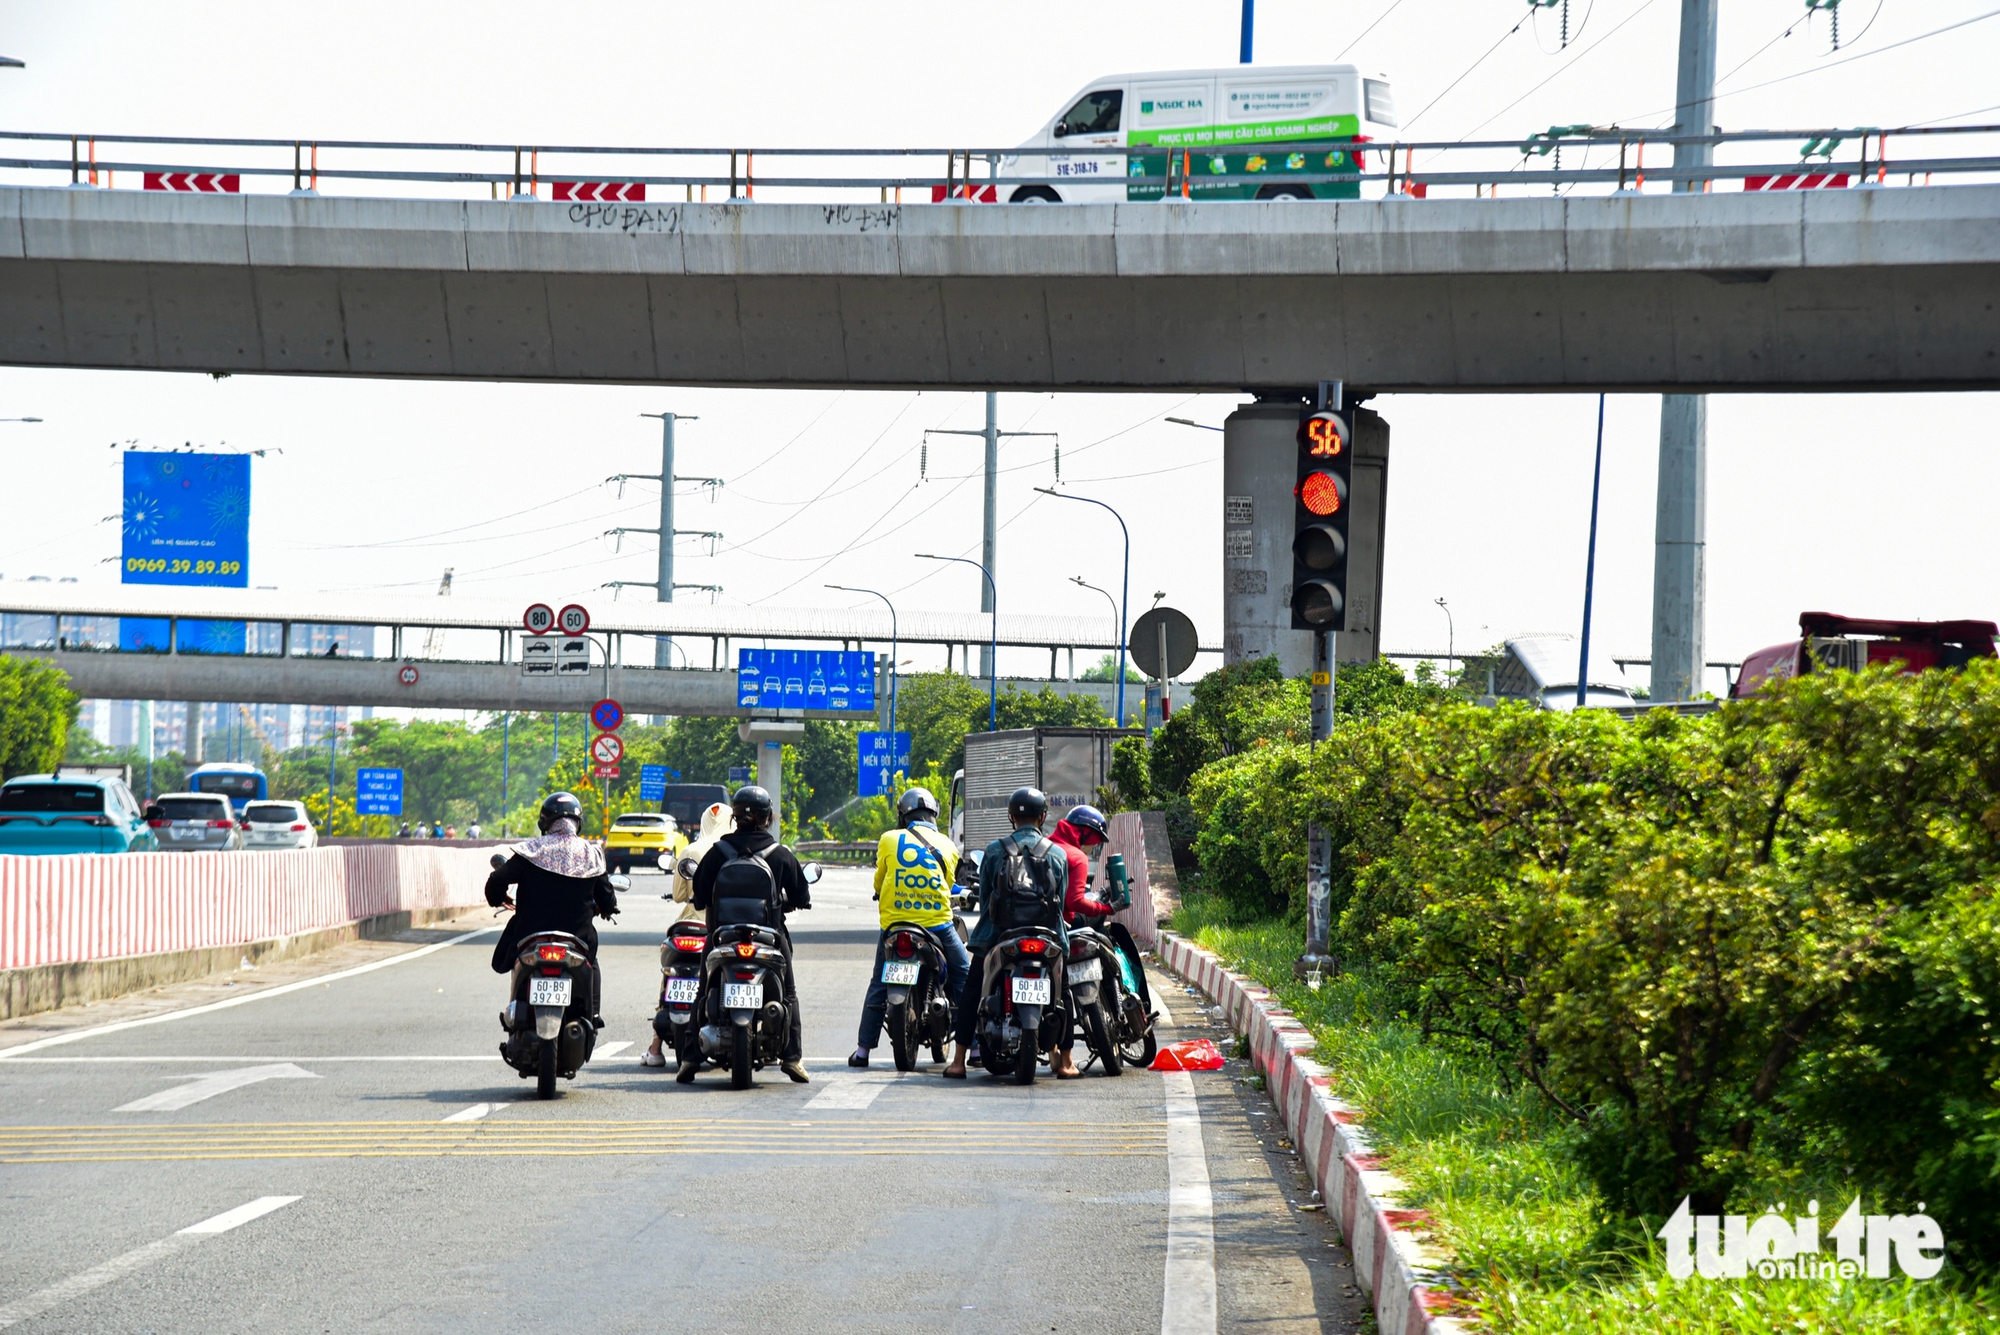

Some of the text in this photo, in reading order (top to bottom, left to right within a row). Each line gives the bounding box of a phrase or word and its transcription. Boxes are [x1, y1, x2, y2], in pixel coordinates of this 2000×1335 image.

[1158, 122, 1339, 145] PHỤC VỤ MỌI NHU CẦU CỦA DOANH NGHIỆP
[1309, 419, 1341, 455] 56
[127, 557, 241, 575] 0969.39.89.89
[532, 611, 547, 626] 80
[566, 612, 582, 627] 60
[1315, 674, 1325, 683] P3
[874, 733, 887, 749] BẾN
[897, 834, 943, 869] be
[895, 869, 942, 890] Food
[888, 963, 914, 974] 66-N1
[536, 980, 565, 991] 60-B9
[672, 980, 697, 991] 81-B2
[730, 985, 756, 996] 61-D1
[1018, 979, 1044, 991] 60-AB
[532, 992, 568, 1004] 392.92
[667, 990, 695, 1001] 499.8
[726, 996, 760, 1007] 663.18
[1014, 991, 1048, 1003] 702.45
